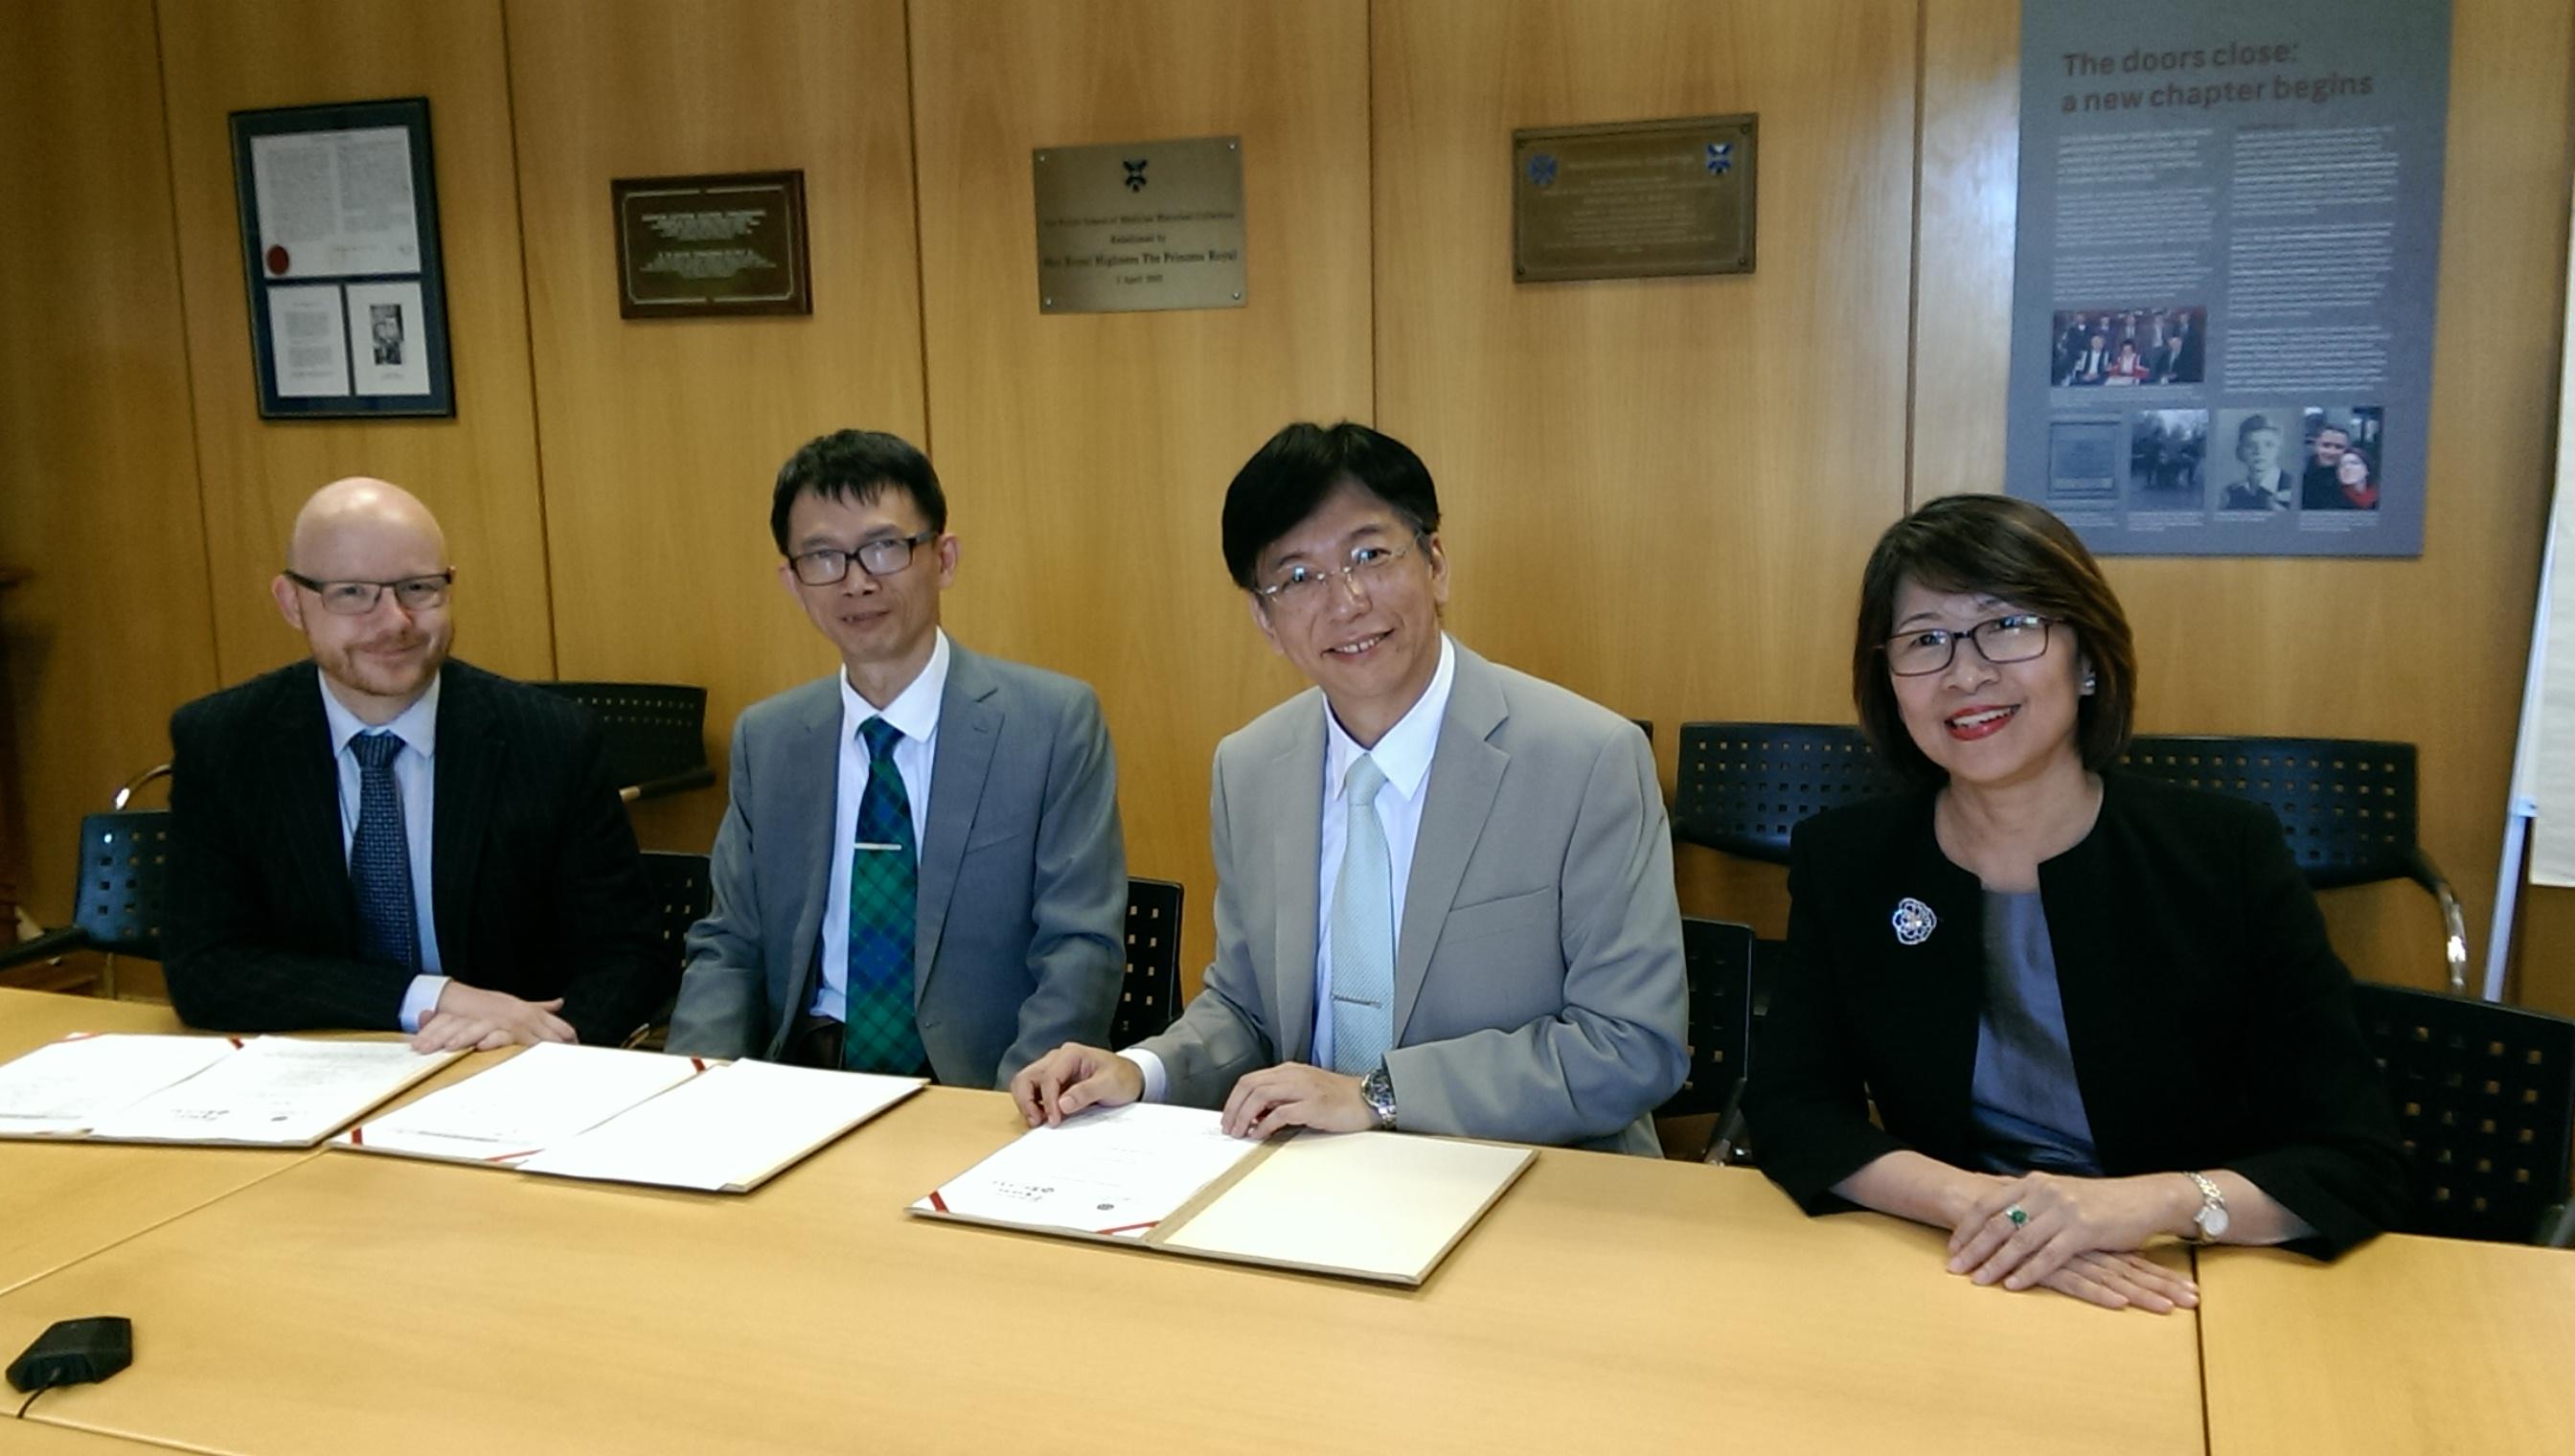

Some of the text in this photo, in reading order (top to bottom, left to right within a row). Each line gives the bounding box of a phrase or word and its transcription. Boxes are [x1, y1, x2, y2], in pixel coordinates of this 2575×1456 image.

[2062, 41, 2298, 77] The doors close:
[2062, 73, 2373, 113] a new chapter begins
[1095, 253, 1139, 268] Highness
[1142, 252, 1160, 264] The
[1164, 250, 1205, 263] Princess
[1209, 248, 1238, 263] Royal
